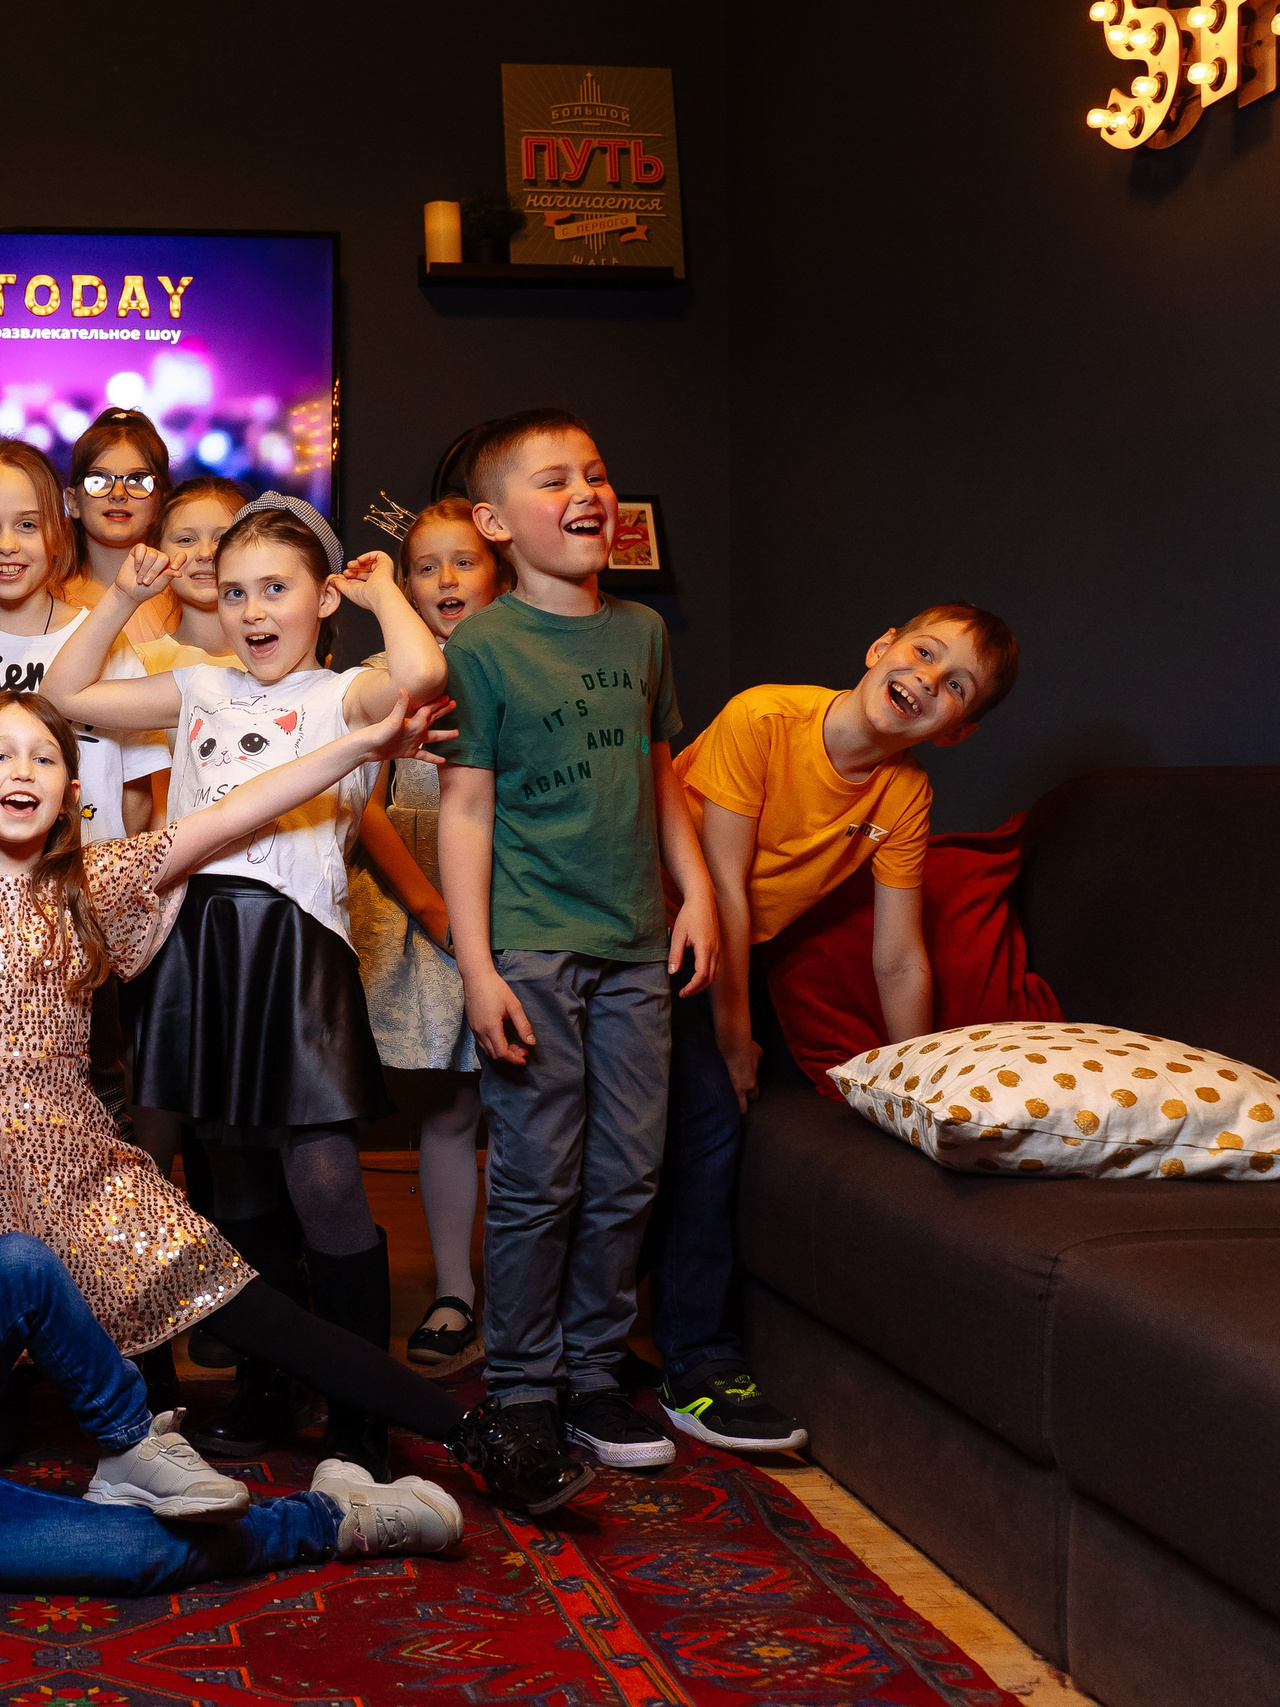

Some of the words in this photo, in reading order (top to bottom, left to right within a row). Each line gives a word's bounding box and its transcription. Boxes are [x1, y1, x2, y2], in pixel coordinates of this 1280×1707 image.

[551, 106, 631, 123] БОЛЬШОЙ
[521, 137, 665, 185] ПУТЬ
[525, 194, 663, 211] начинается
[576, 216, 629, 234] ПЕРВОГО
[144, 328, 182, 345] шоу
[581, 668, 633, 691] DÉJÀ
[587, 728, 624, 751] AND
[523, 761, 592, 801] AGAIN
